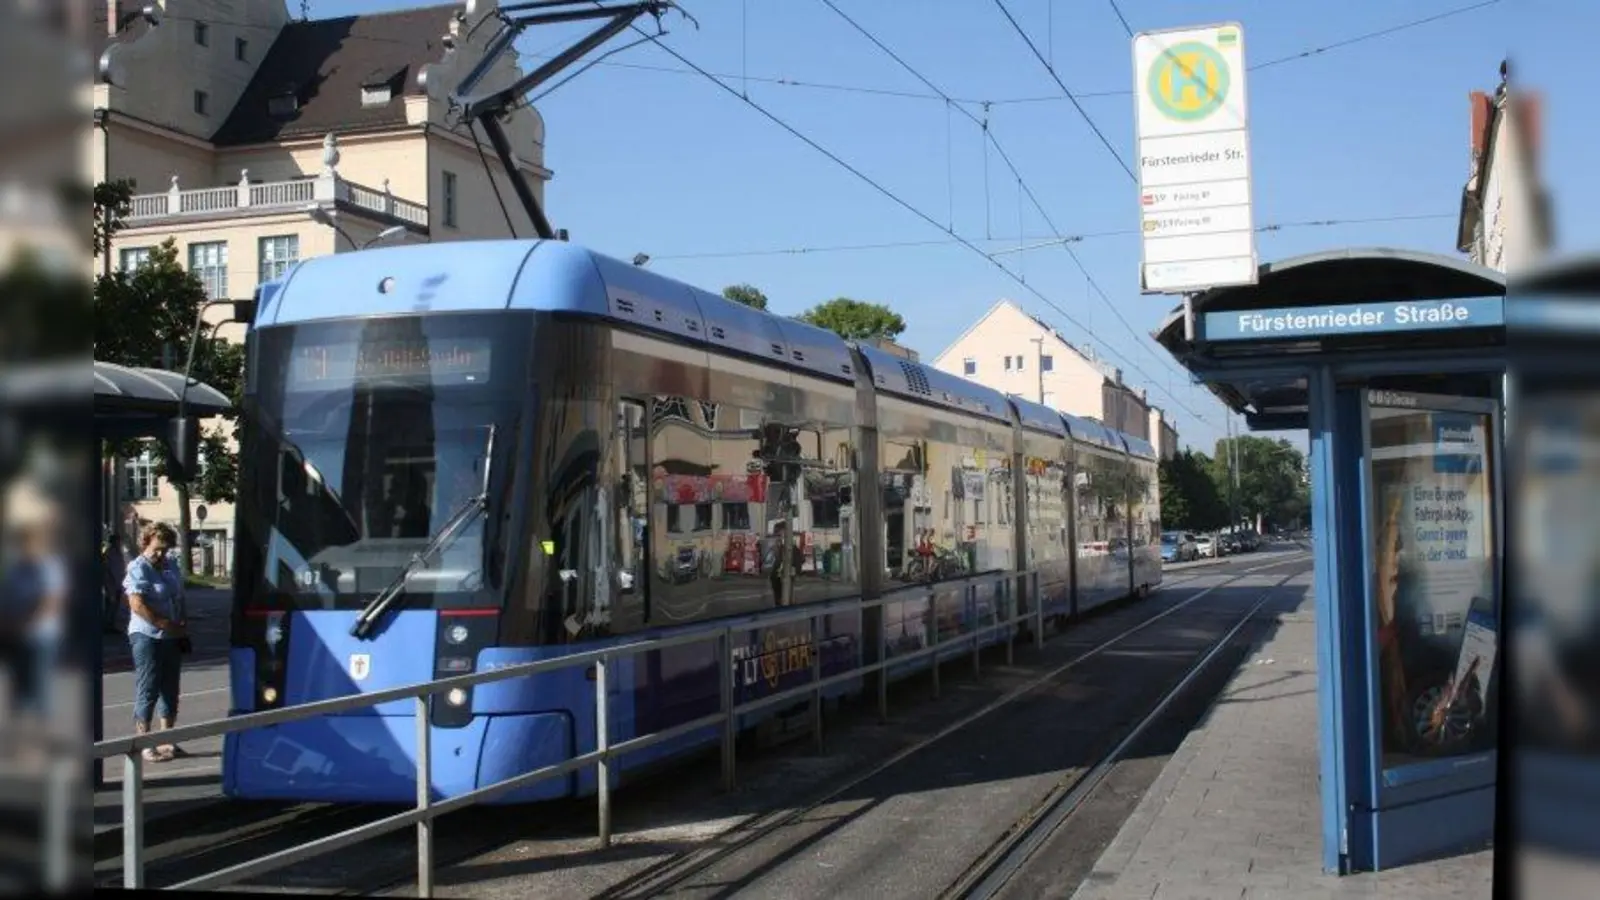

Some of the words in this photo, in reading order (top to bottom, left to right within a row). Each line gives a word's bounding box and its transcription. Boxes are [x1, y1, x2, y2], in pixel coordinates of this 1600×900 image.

[1141, 151, 1220, 167] Fürstenrieder
[1224, 147, 1244, 161] Str.
[1238, 308, 1385, 333] Fürstenrieder
[1394, 303, 1469, 325] Straße
